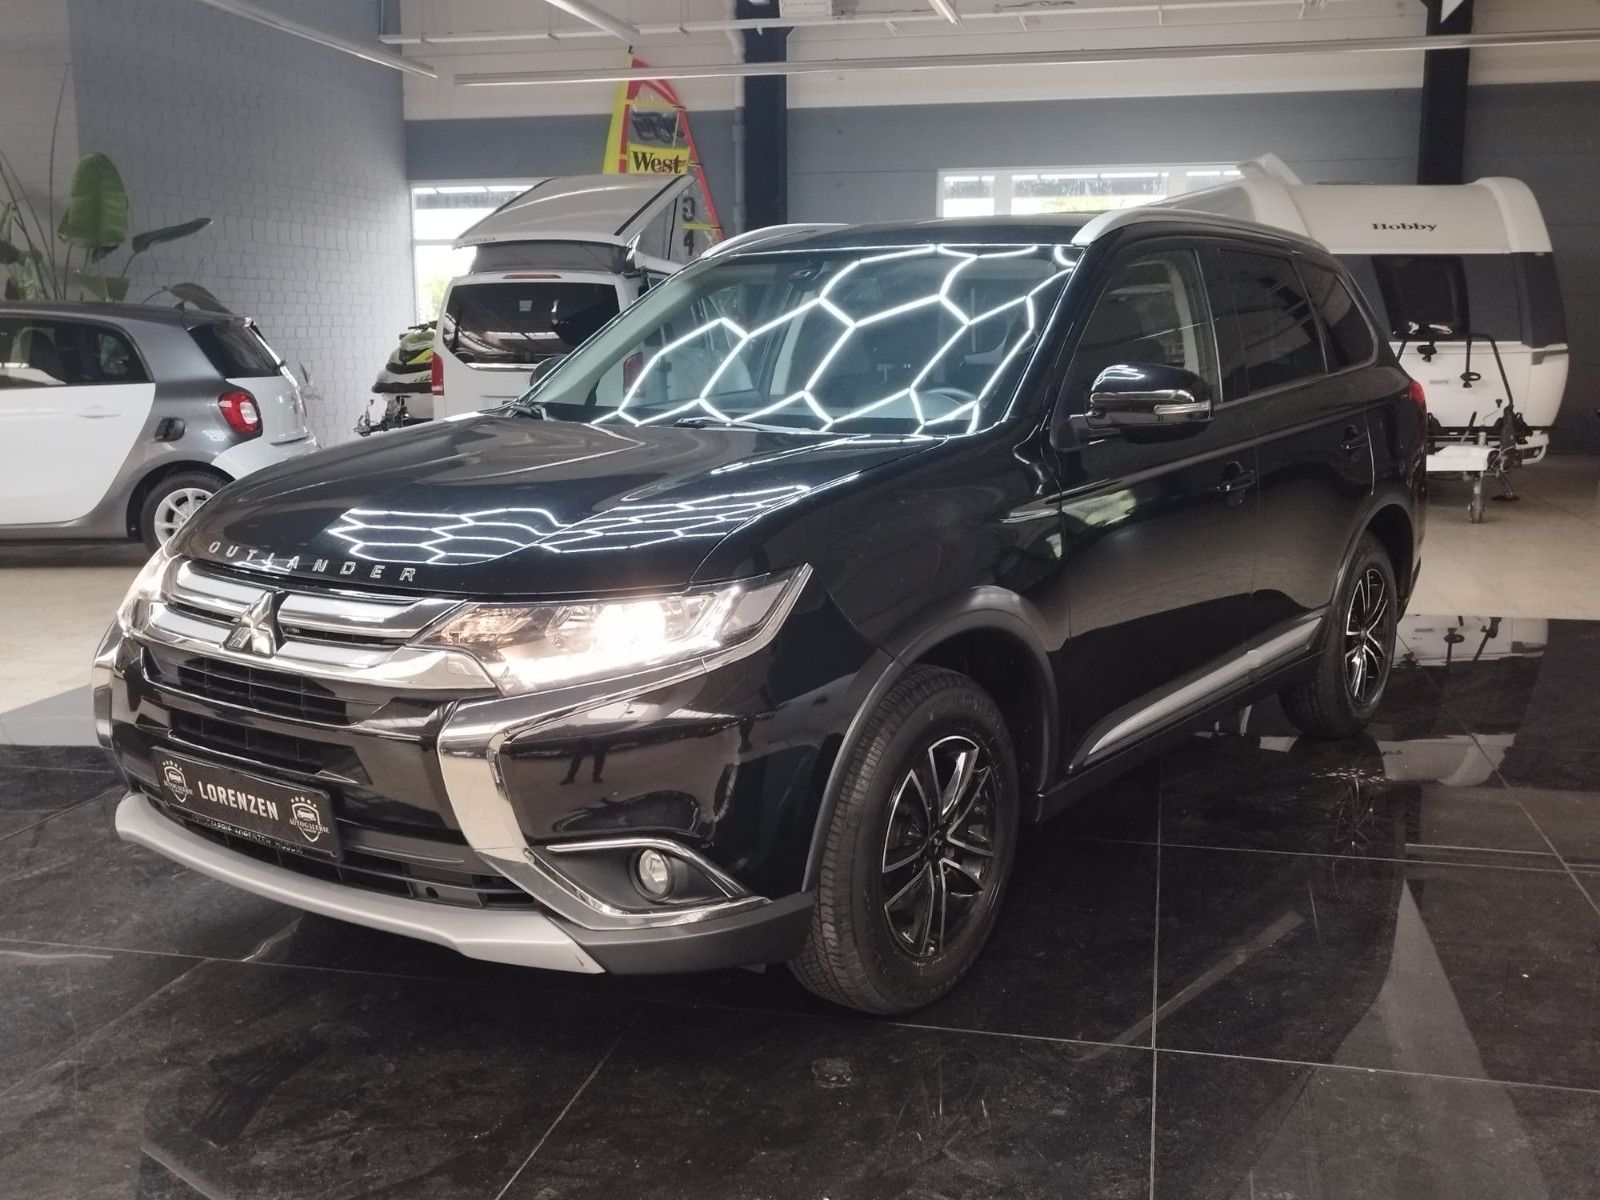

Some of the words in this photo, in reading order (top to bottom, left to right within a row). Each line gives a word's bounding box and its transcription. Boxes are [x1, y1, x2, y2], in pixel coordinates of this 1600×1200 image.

[631, 150, 683, 174] West
[1372, 222, 1437, 232] Hobby
[208, 541, 416, 582] OUTLANDER
[198, 780, 279, 821] LORENZEN
